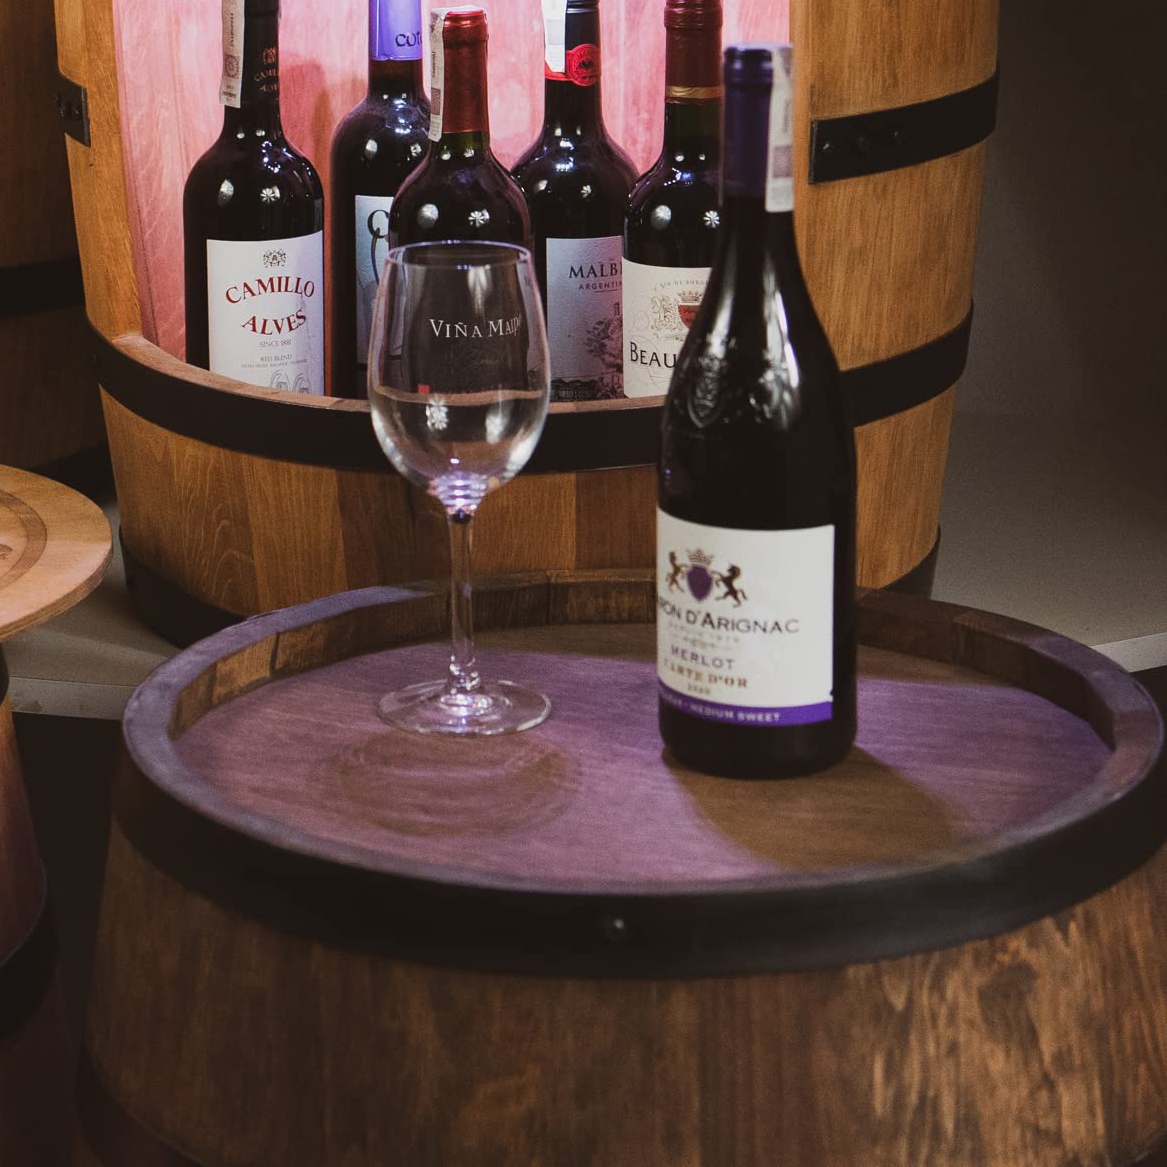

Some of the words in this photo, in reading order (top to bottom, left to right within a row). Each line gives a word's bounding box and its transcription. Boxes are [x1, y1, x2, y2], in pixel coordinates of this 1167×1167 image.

[568, 261, 622, 279] MALB
[225, 276, 315, 304] CAMILLO
[242, 309, 306, 335] ALVES
[429, 318, 483, 338] VIÑA
[259, 340, 279, 348] SINCE
[274, 354, 293, 362] BLEND
[685, 610, 800, 634] D'ARIGNAC
[671, 645, 735, 670] MERLOT
[708, 674, 748, 688] D'OR
[689, 702, 734, 719] MEDIUM
[737, 712, 781, 722] SWEET
